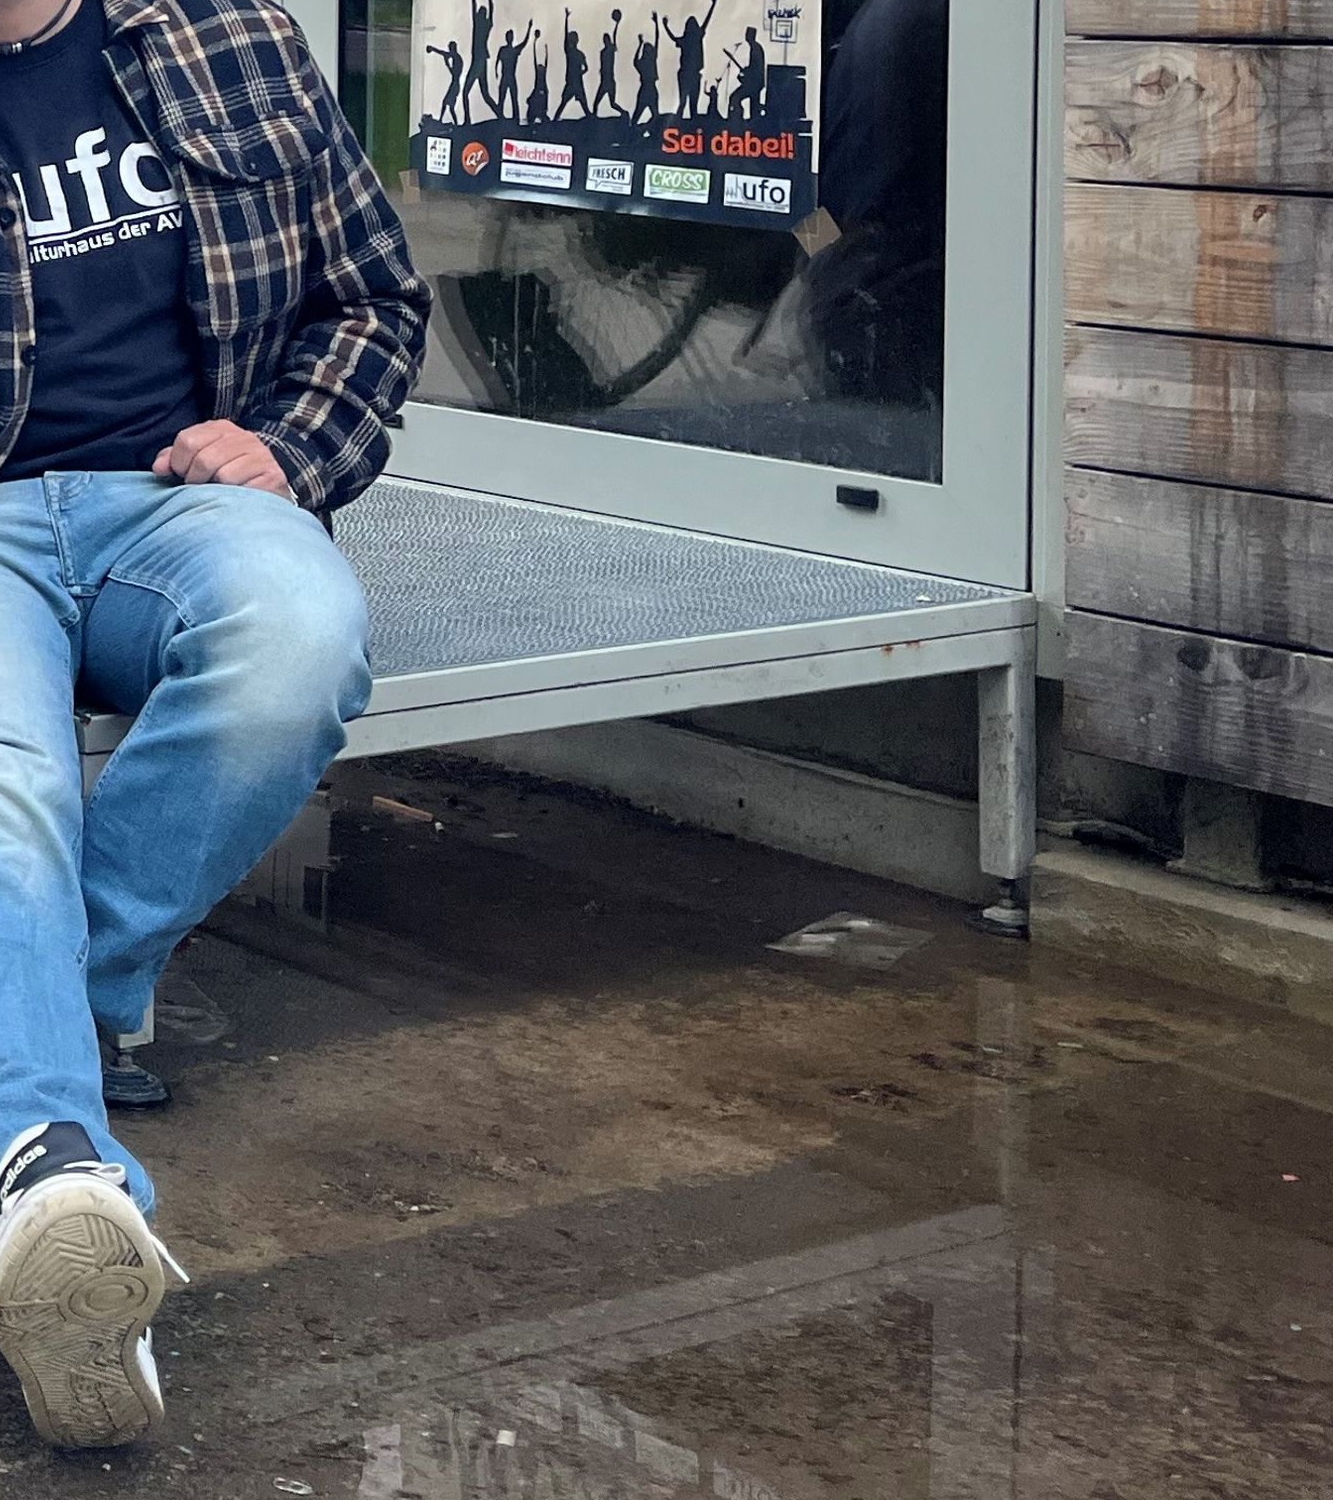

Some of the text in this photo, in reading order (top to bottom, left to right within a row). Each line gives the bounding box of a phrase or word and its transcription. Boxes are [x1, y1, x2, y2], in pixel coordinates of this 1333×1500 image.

[514, 146, 572, 164] leichtsinn
[662, 127, 795, 161] Sei dabei!
[12, 126, 181, 238] ufo
[650, 169, 704, 190] CROSS
[743, 179, 784, 204] ufo
[118, 222, 151, 240] der
[0, 1144, 47, 1201] adidas
